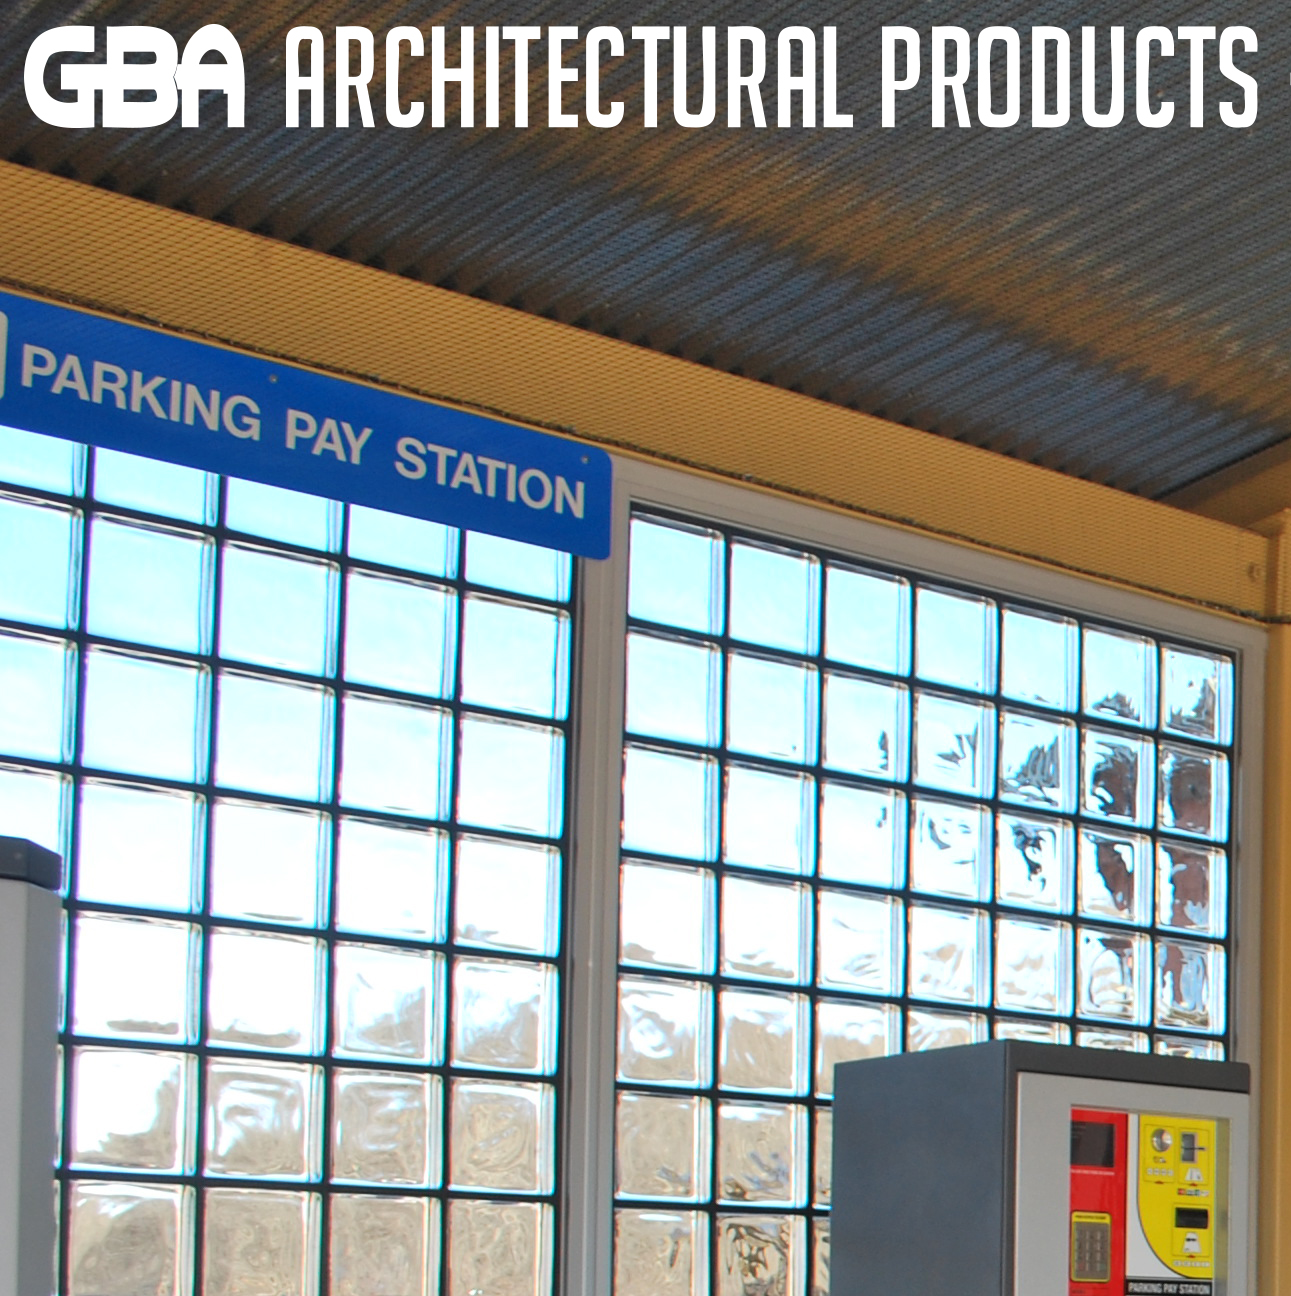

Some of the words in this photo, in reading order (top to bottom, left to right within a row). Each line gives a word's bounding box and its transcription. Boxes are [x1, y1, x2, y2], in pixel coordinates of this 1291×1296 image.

[21, 343, 262, 441] PARKING
[285, 408, 373, 465] PAY
[395, 437, 586, 519] STATION
[1128, 1282, 1162, 1295] PARKING
[1163, 1283, 1178, 1294] PAY
[1179, 1284, 1211, 1295] STATION
